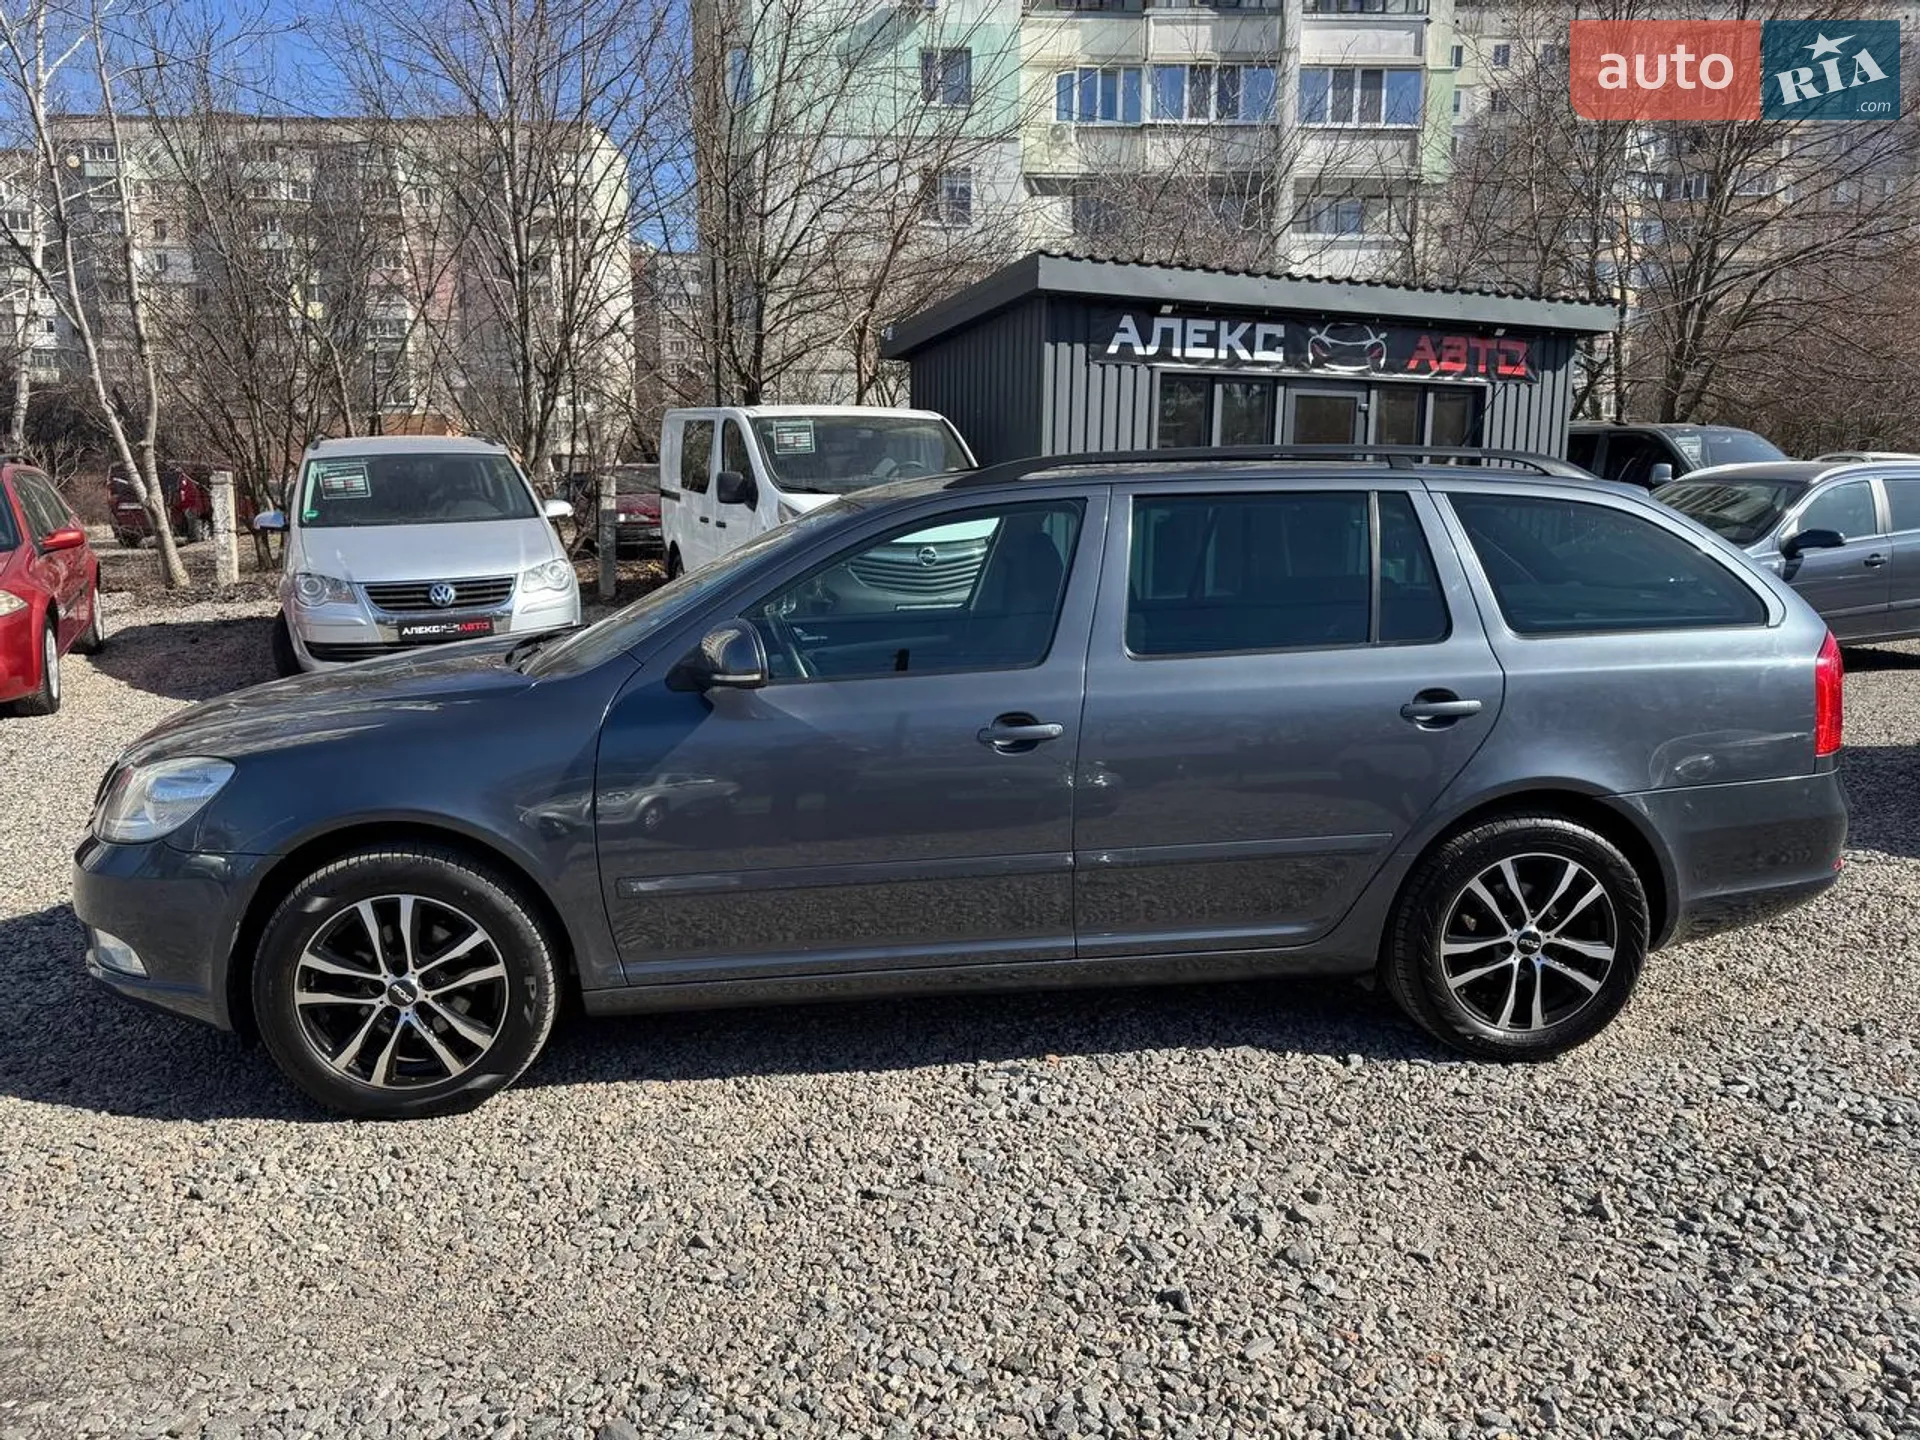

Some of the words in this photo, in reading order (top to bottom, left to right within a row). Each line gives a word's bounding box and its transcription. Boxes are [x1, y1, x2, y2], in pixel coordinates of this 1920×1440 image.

[1106, 314, 1285, 362] АЛЕКС
[1407, 334, 1528, 377] АВТО
[402, 626, 440, 635] АЛЕКС
[461, 622, 489, 632] АВТО
